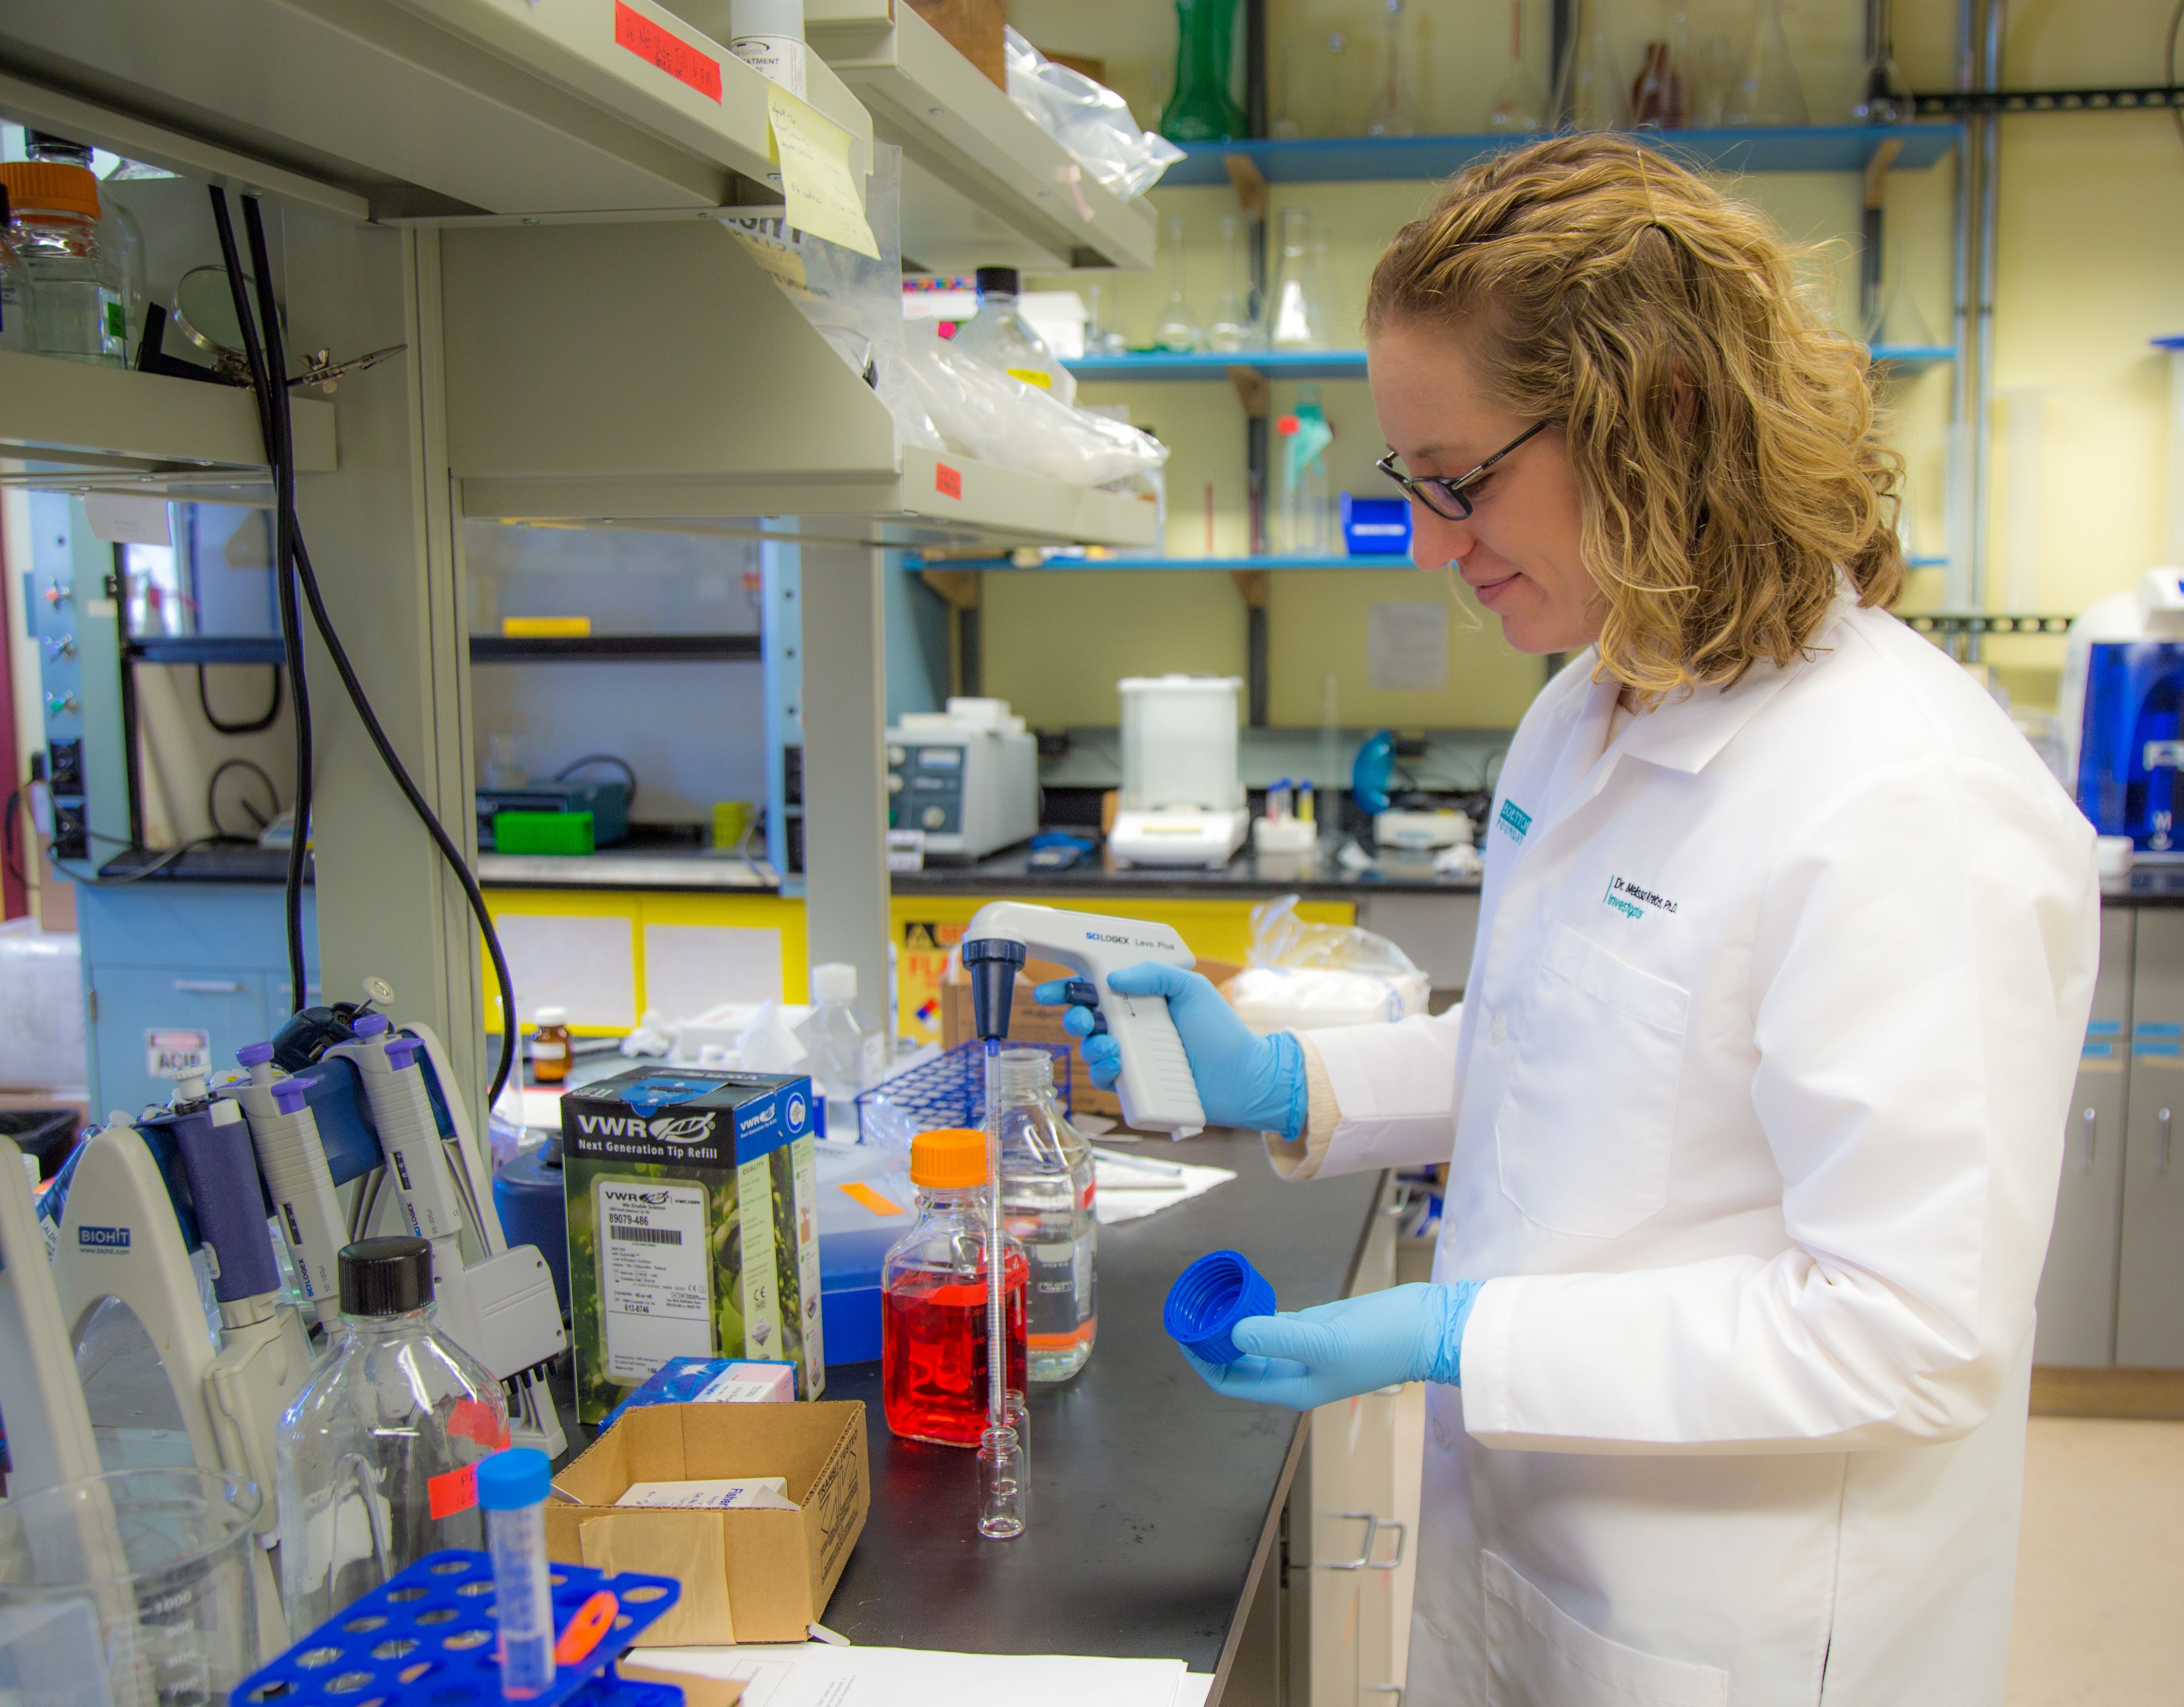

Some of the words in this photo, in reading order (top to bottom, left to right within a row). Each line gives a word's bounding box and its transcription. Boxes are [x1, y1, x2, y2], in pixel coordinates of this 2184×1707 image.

[1607, 892, 1644, 919] Investigator
[1086, 932, 1130, 945] SCILOGEX
[1135, 938, 1154, 948] Levo
[1157, 941, 1175, 950] Plus
[577, 1114, 647, 1138] VWR
[740, 1116, 760, 1131] VWR
[577, 1138, 602, 1151] Next
[607, 1141, 664, 1156] Generation
[667, 1146, 684, 1158] Tip
[687, 1148, 717, 1160] Refill
[742, 1160, 765, 1175] QUALITY
[605, 1191, 638, 1202] VWR
[609, 1213, 649, 1226] 89079-486
[298, 1258, 314, 1298] SCILOGEX
[625, 1304, 650, 1313] 613-0746
[756, 1301, 765, 1310] IVD
[818, 1459, 841, 1498] TRANSIT
[840, 1429, 858, 1460] TESTED
[720, 1488, 744, 1506] Fisher
